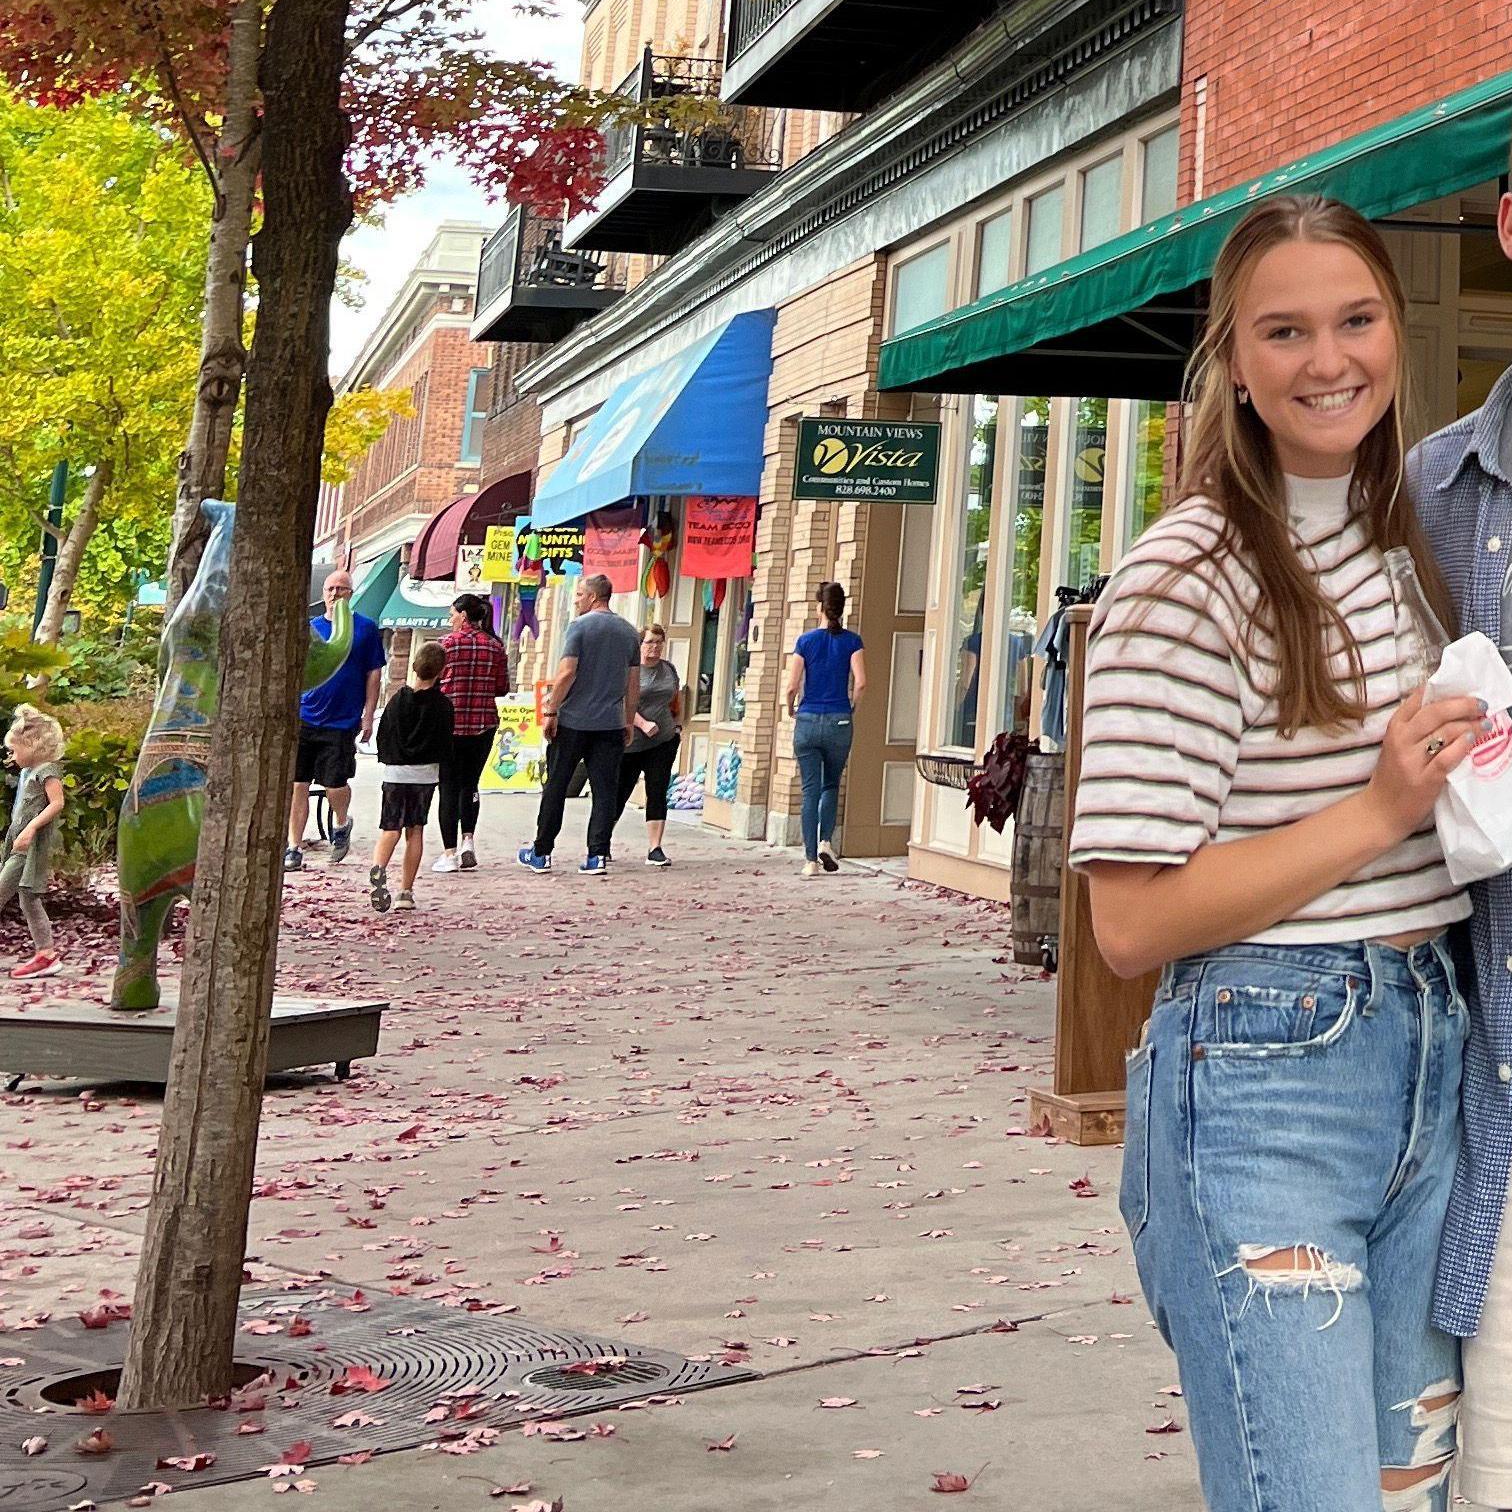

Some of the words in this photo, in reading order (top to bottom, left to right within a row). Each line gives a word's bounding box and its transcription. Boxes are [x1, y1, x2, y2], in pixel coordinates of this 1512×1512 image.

[817, 425, 882, 438] MOUNTAIN
[886, 427, 923, 439] VIEWS
[845, 440, 924, 473] Vista
[688, 521, 718, 530] TEAM
[491, 539, 510, 550] GEM
[487, 551, 513, 562] MINE
